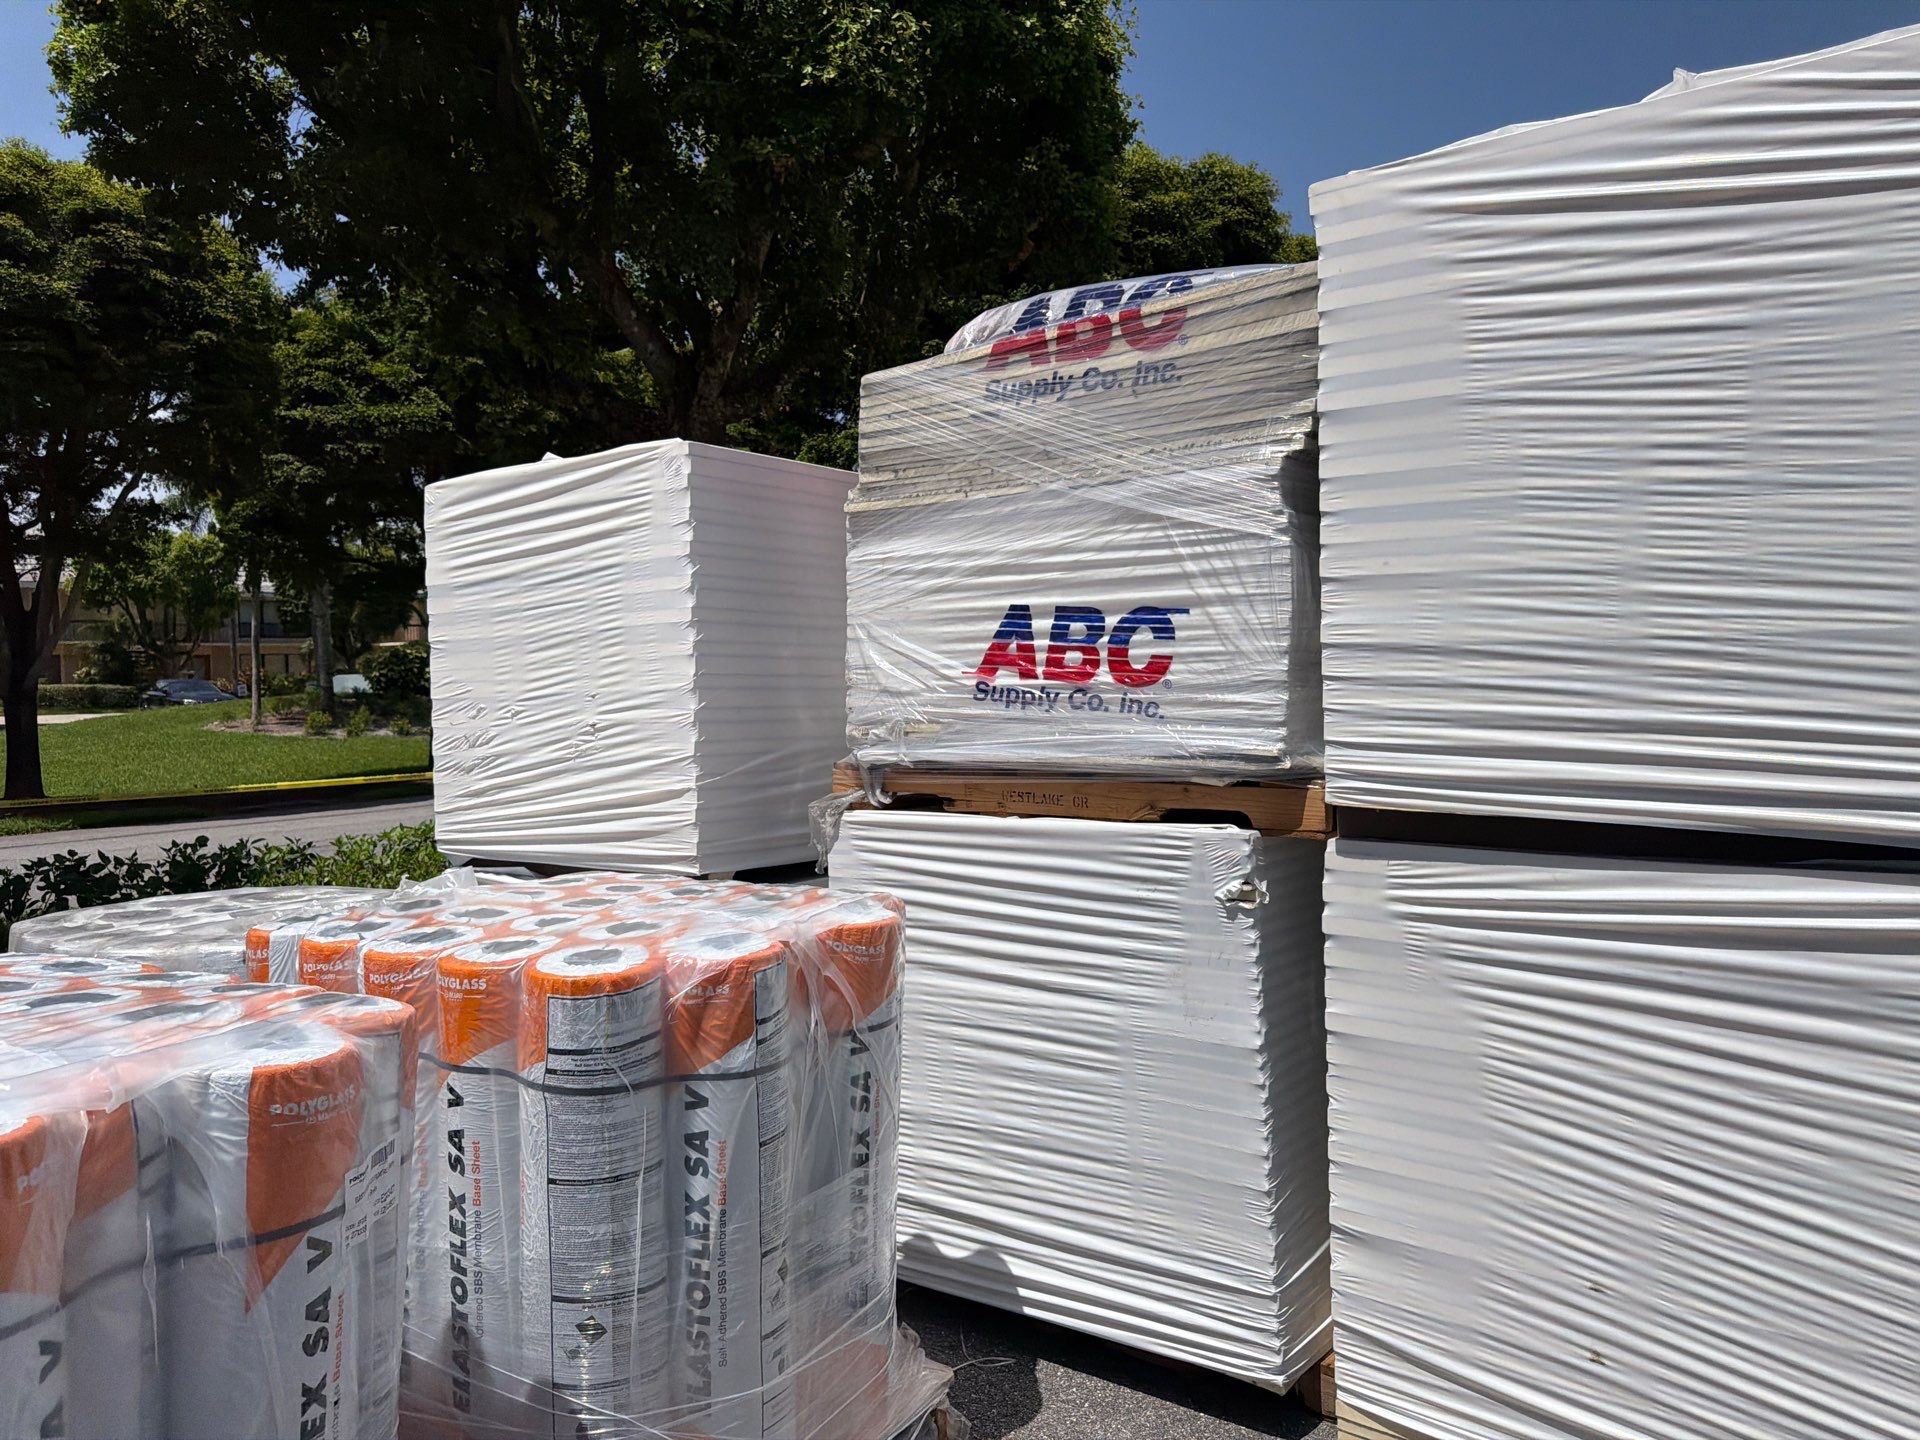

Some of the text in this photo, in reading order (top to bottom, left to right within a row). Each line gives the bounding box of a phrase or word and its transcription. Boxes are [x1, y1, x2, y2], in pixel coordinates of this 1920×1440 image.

[986, 271, 1214, 370] ABC
[985, 370, 1074, 408] Supply
[1081, 366, 1123, 393] Co.
[962, 604, 1190, 688] ABC
[973, 681, 1060, 712] Supply
[1067, 688, 1110, 713] Co.
[681, 983, 732, 997] GLASS
[269, 1084, 356, 1116] POLYGLASS
[684, 1083, 710, 1112] V
[850, 1071, 872, 1113] SA
[471, 1140, 481, 1174] Sheet
[683, 1130, 710, 1180] SA
[717, 1140, 727, 1174] Sheet
[472, 1178, 482, 1207] Base
[717, 1176, 727, 1206] Base
[446, 1081, 471, 1415] ELASTOFLEX SA V
[472, 1210, 483, 1268] Membrane
[717, 1209, 727, 1268] Membrane
[473, 1271, 483, 1295] SBS
[718, 1270, 727, 1294] SBS
[301, 1236, 333, 1440] EX SA V
